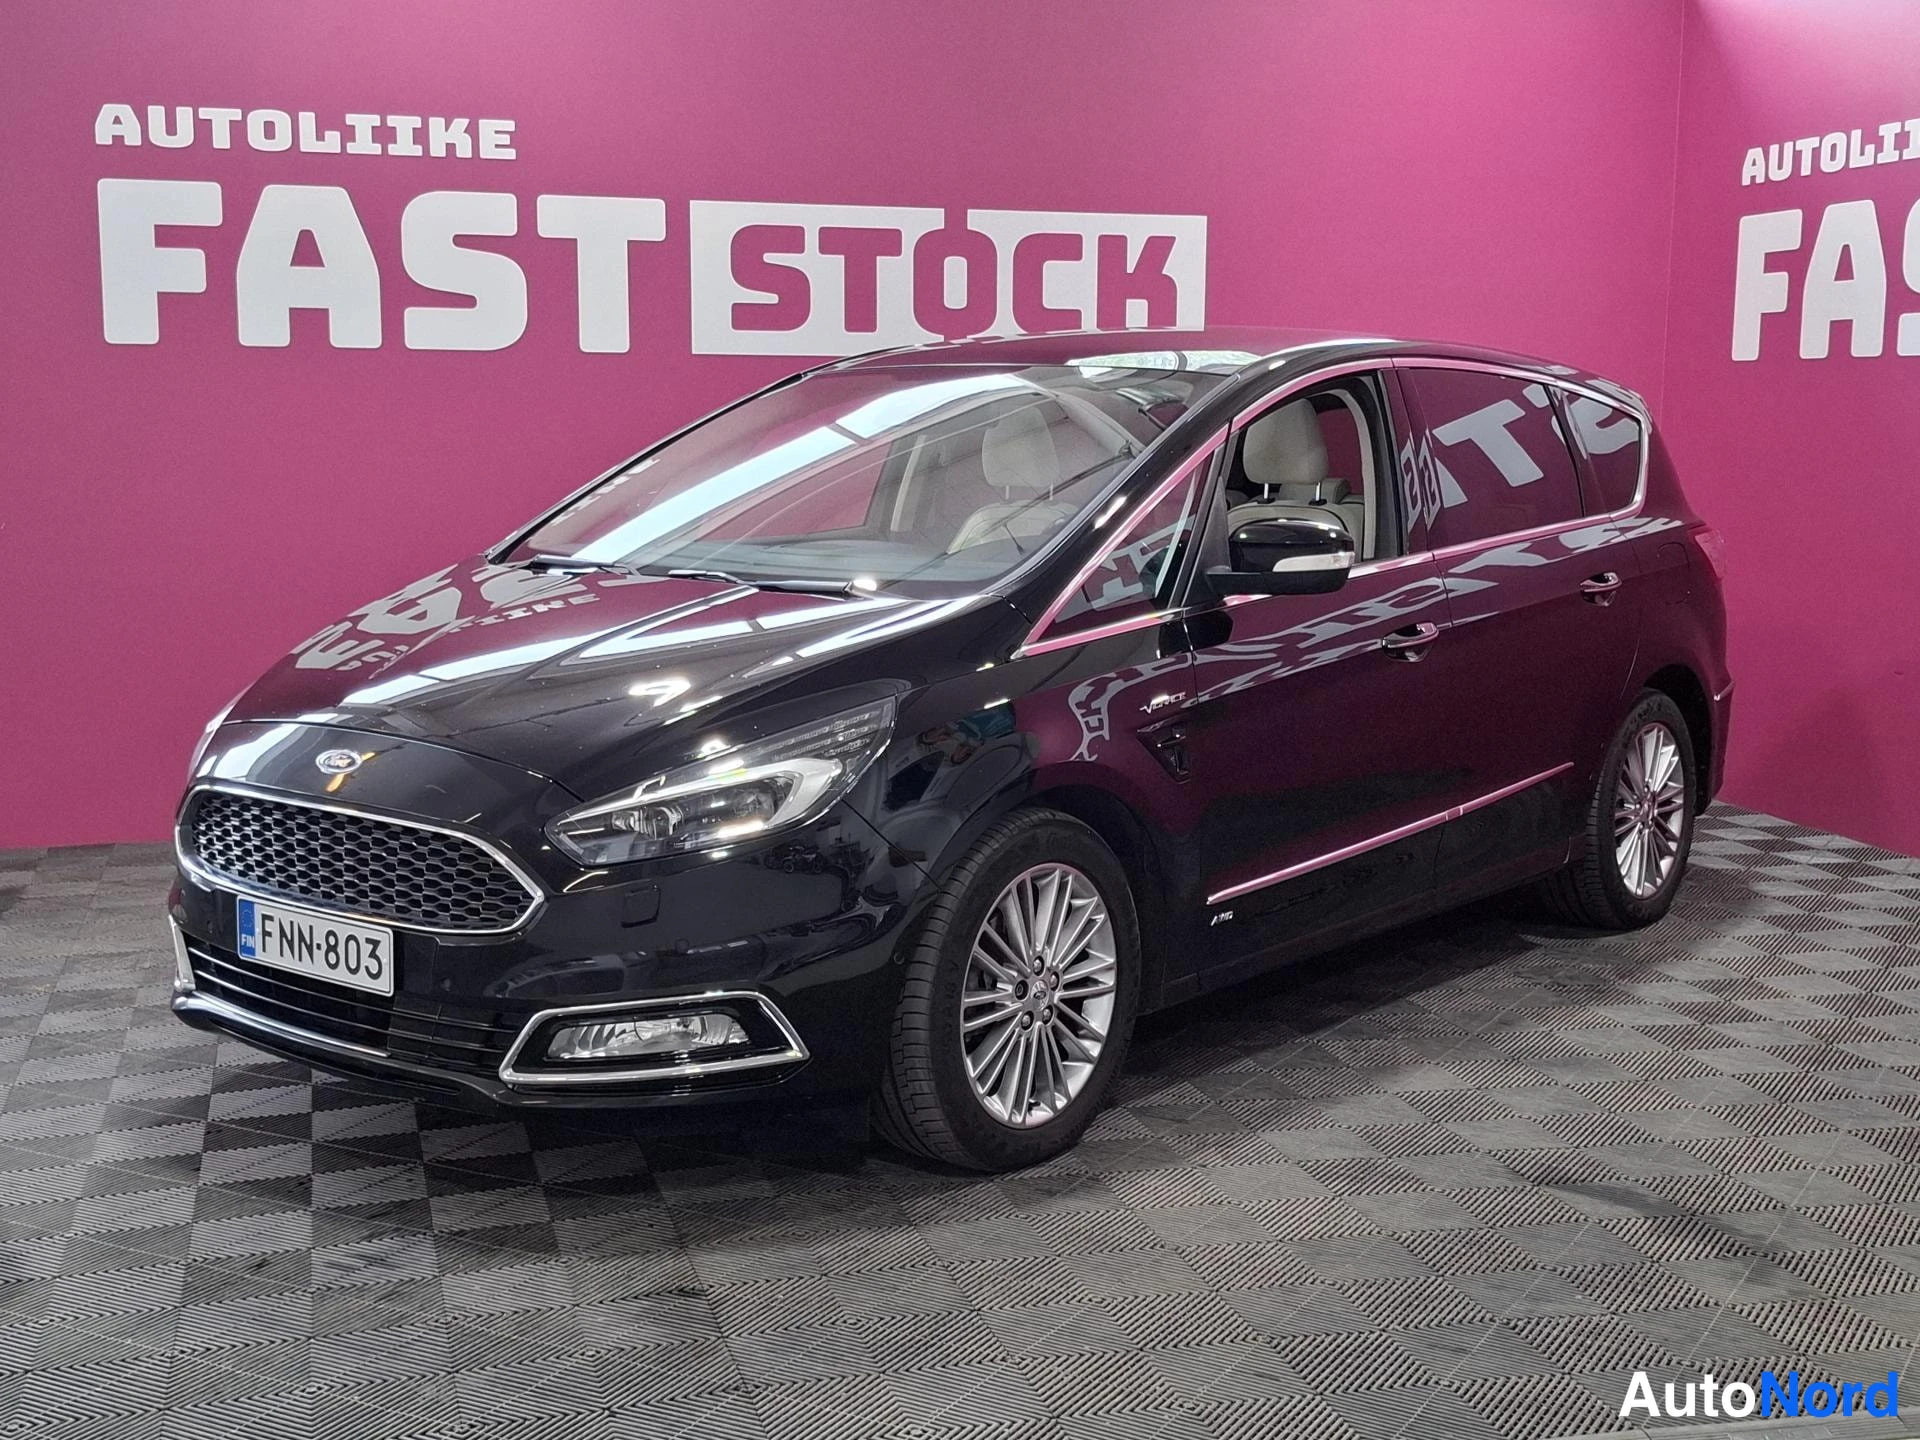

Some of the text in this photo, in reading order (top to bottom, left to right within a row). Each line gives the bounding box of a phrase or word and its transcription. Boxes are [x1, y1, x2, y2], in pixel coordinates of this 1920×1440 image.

[95, 103, 517, 160] AUTOLIIKE
[97, 178, 668, 354] FAST
[241, 933, 256, 948] FIN
[261, 913, 383, 980] FNN-803
